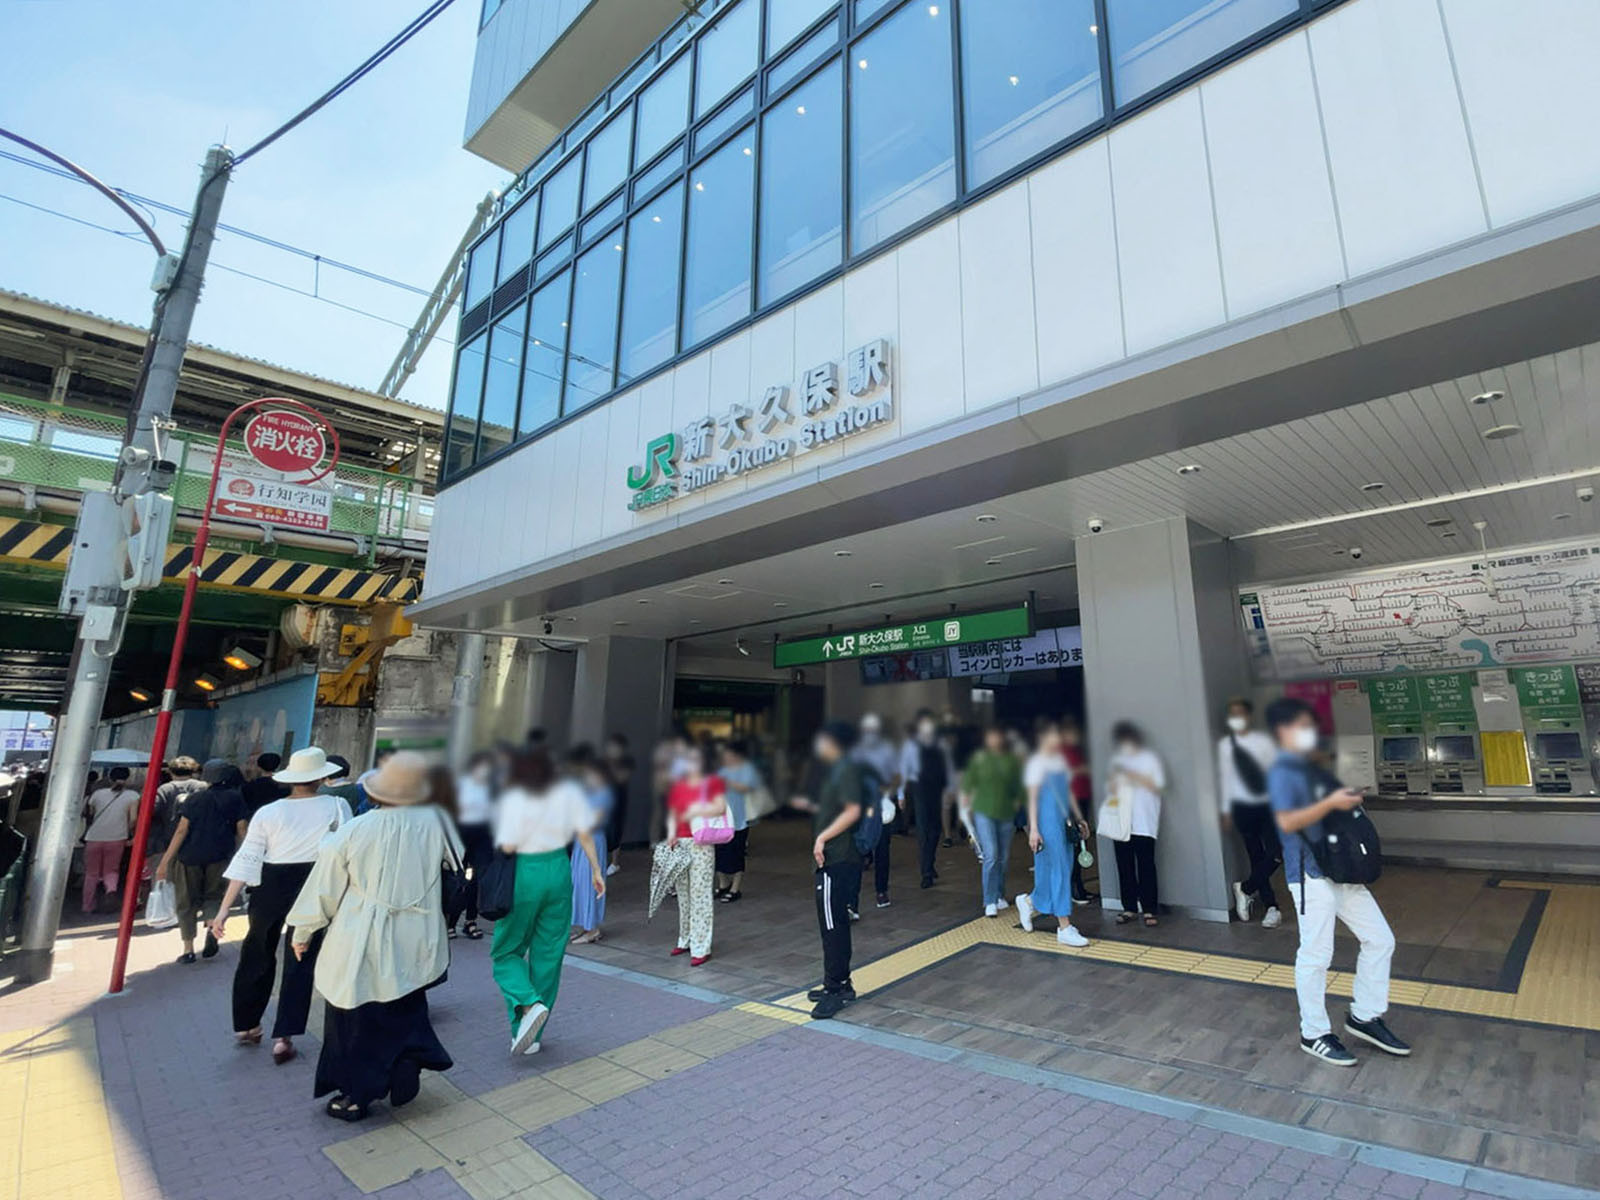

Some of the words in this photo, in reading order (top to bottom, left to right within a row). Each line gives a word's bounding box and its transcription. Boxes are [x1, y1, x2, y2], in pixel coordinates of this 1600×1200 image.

[682, 338, 889, 463] 新大久保駅
[262, 415, 279, 426] FIRE
[281, 420, 315, 433] HYDRANT
[252, 424, 319, 460] 消火栓
[682, 438, 795, 492] Shin-Okubo
[800, 401, 891, 449] Station
[627, 432, 678, 490] JR
[258, 483, 327, 507] 行知学园
[858, 629, 903, 646] 新大久保駅
[913, 625, 926, 635] 入口
[836, 635, 855, 652] JR
[858, 644, 889, 655] Shin-Okubo
[890, 642, 909, 651] Station
[1426, 676, 1460, 689] きっぷ
[1525, 668, 1563, 683] きっぷ
[1376, 679, 1408, 692] きっぷ
